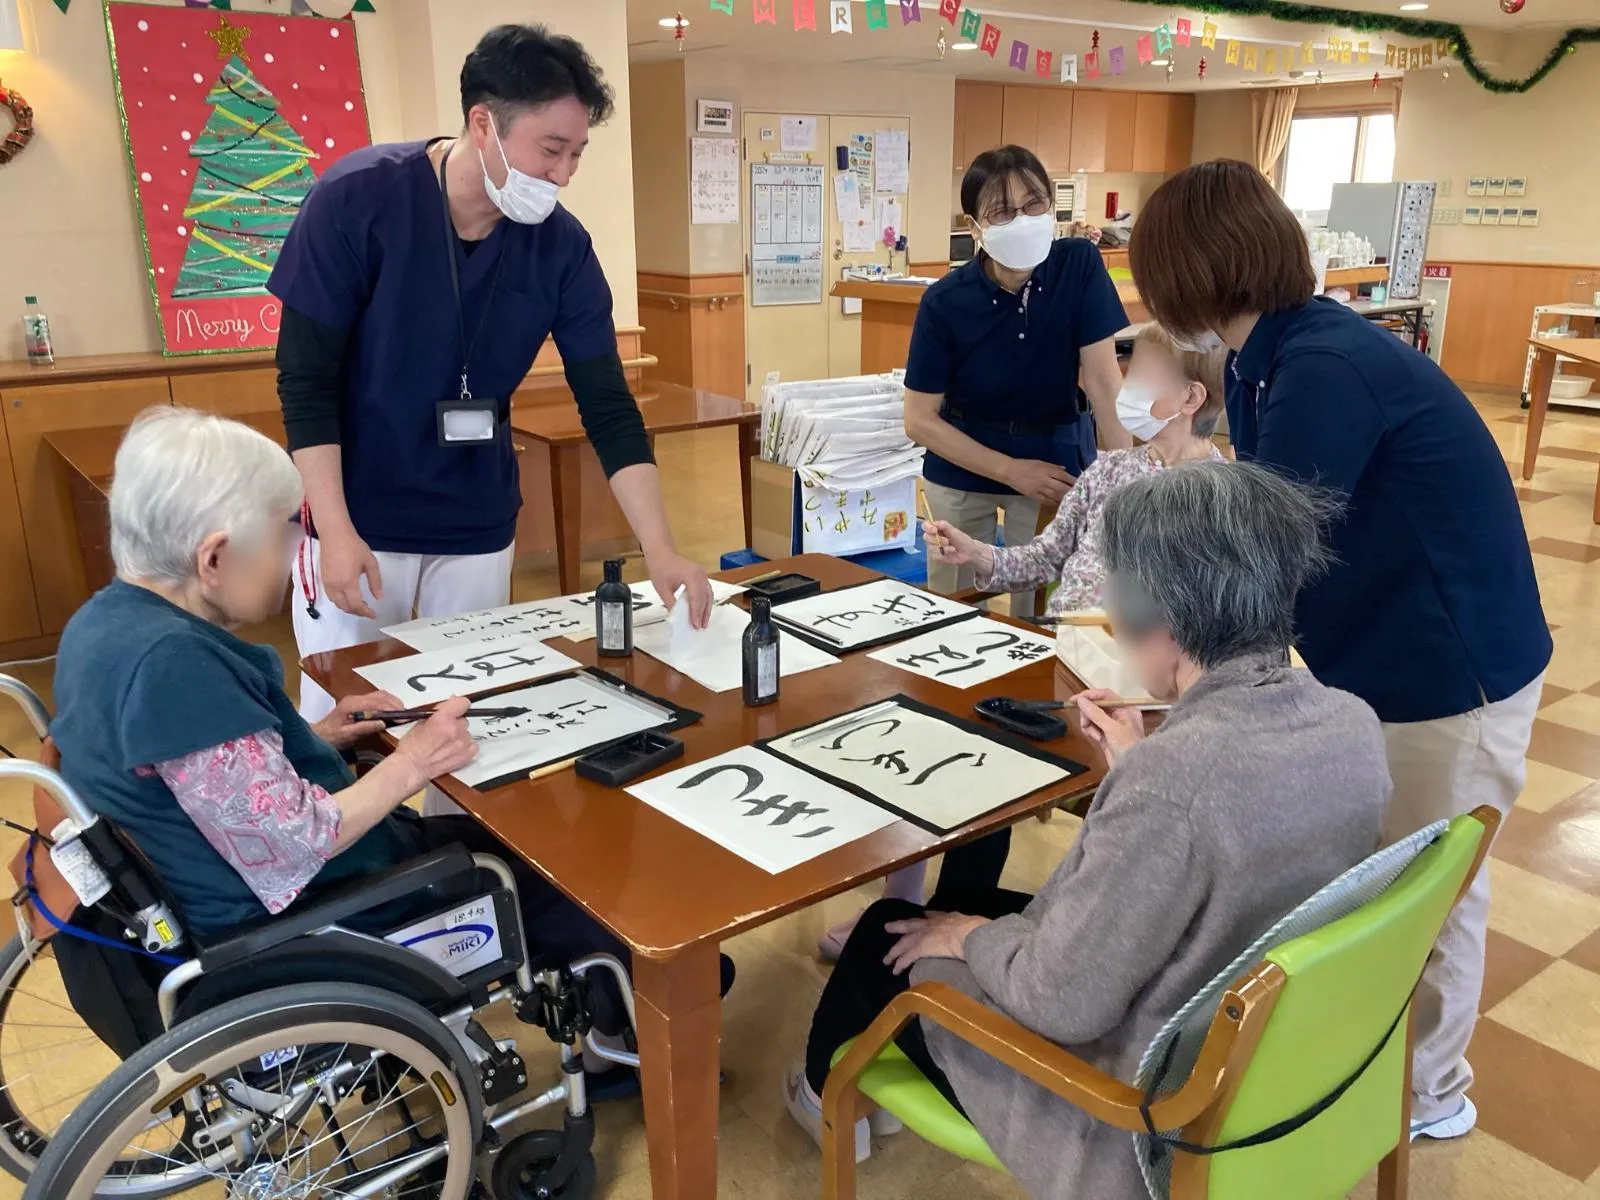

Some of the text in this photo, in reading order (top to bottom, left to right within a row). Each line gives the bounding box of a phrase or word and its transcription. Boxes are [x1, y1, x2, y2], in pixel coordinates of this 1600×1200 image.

[176, 308, 255, 343] Merry
[407, 648, 544, 692] はと
[676, 764, 835, 839] つき
